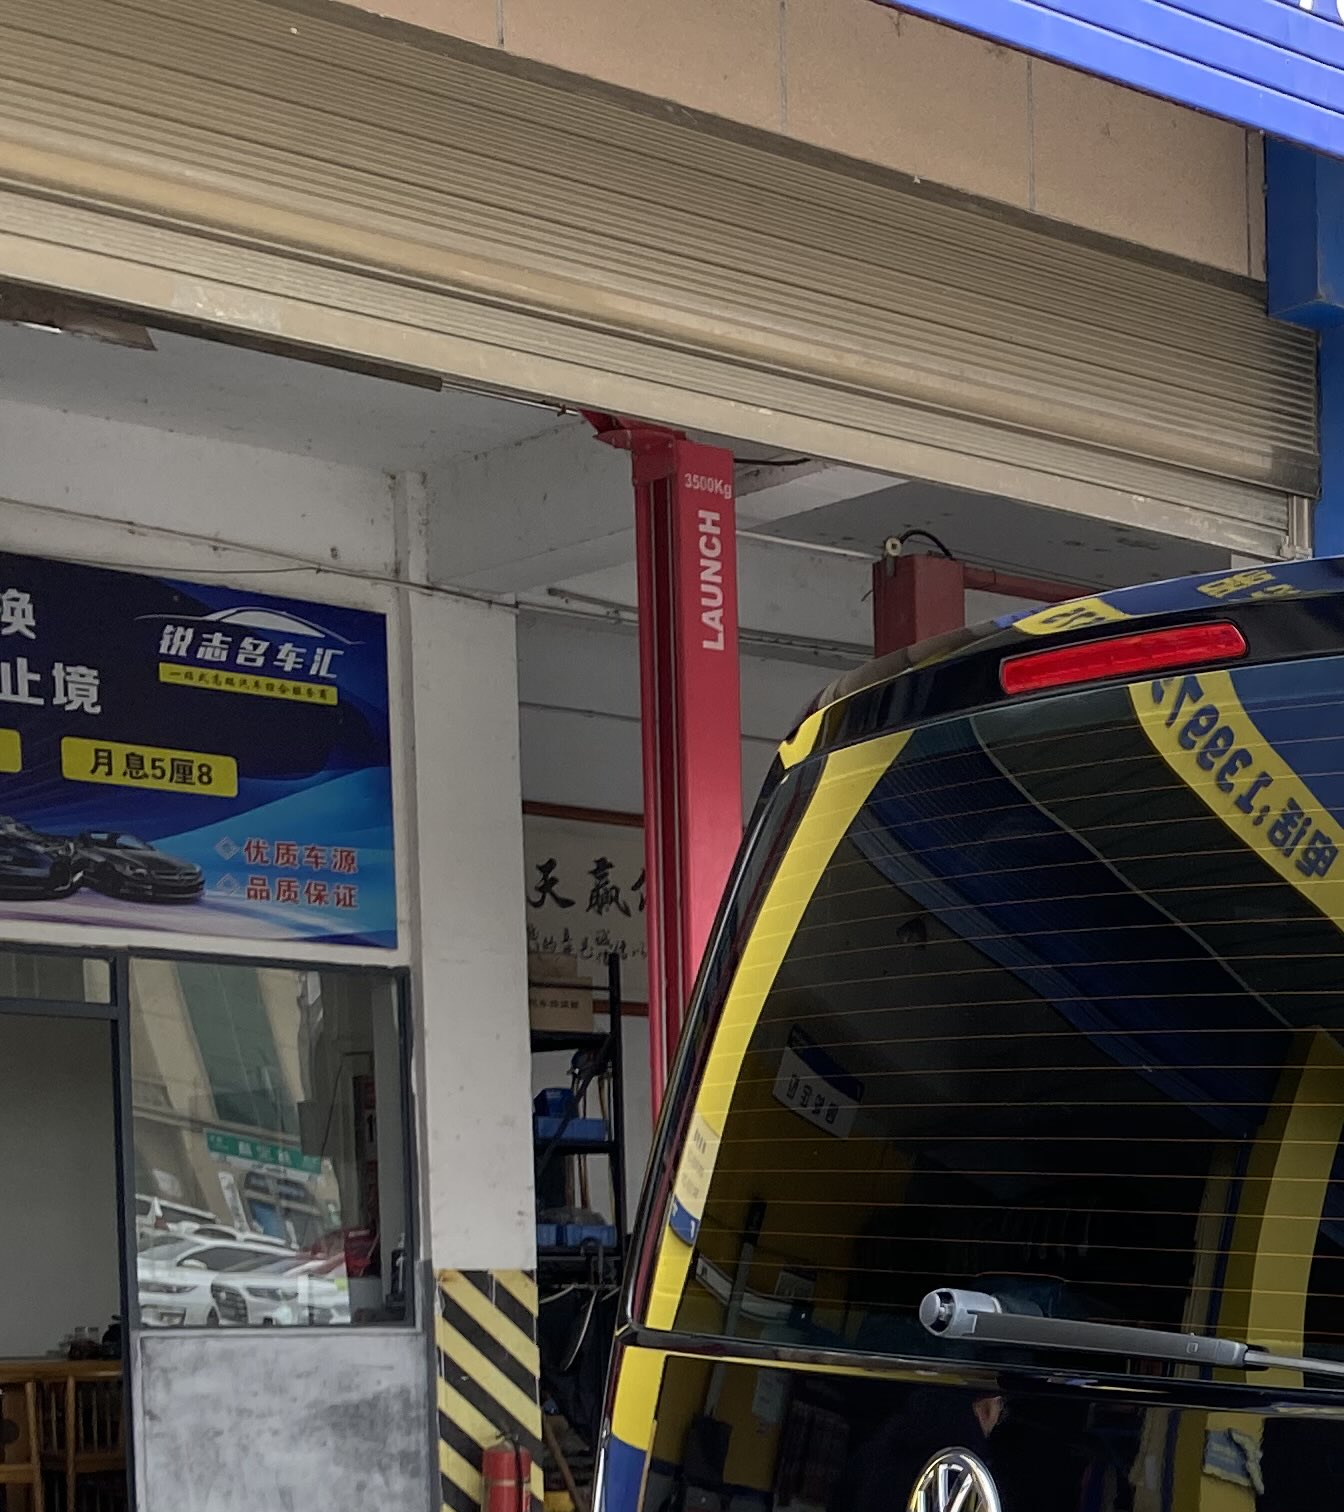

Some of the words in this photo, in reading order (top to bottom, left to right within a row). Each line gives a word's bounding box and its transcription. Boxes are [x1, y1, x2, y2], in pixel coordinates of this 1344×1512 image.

[685, 473, 732, 500] 3500Kg
[698, 509, 725, 651] LAUNCH
[158, 624, 345, 679] 锐志名车汇
[90, 748, 214, 788] 月息5厘8
[243, 836, 360, 875] 优质车源
[245, 875, 359, 910] 品质保证
